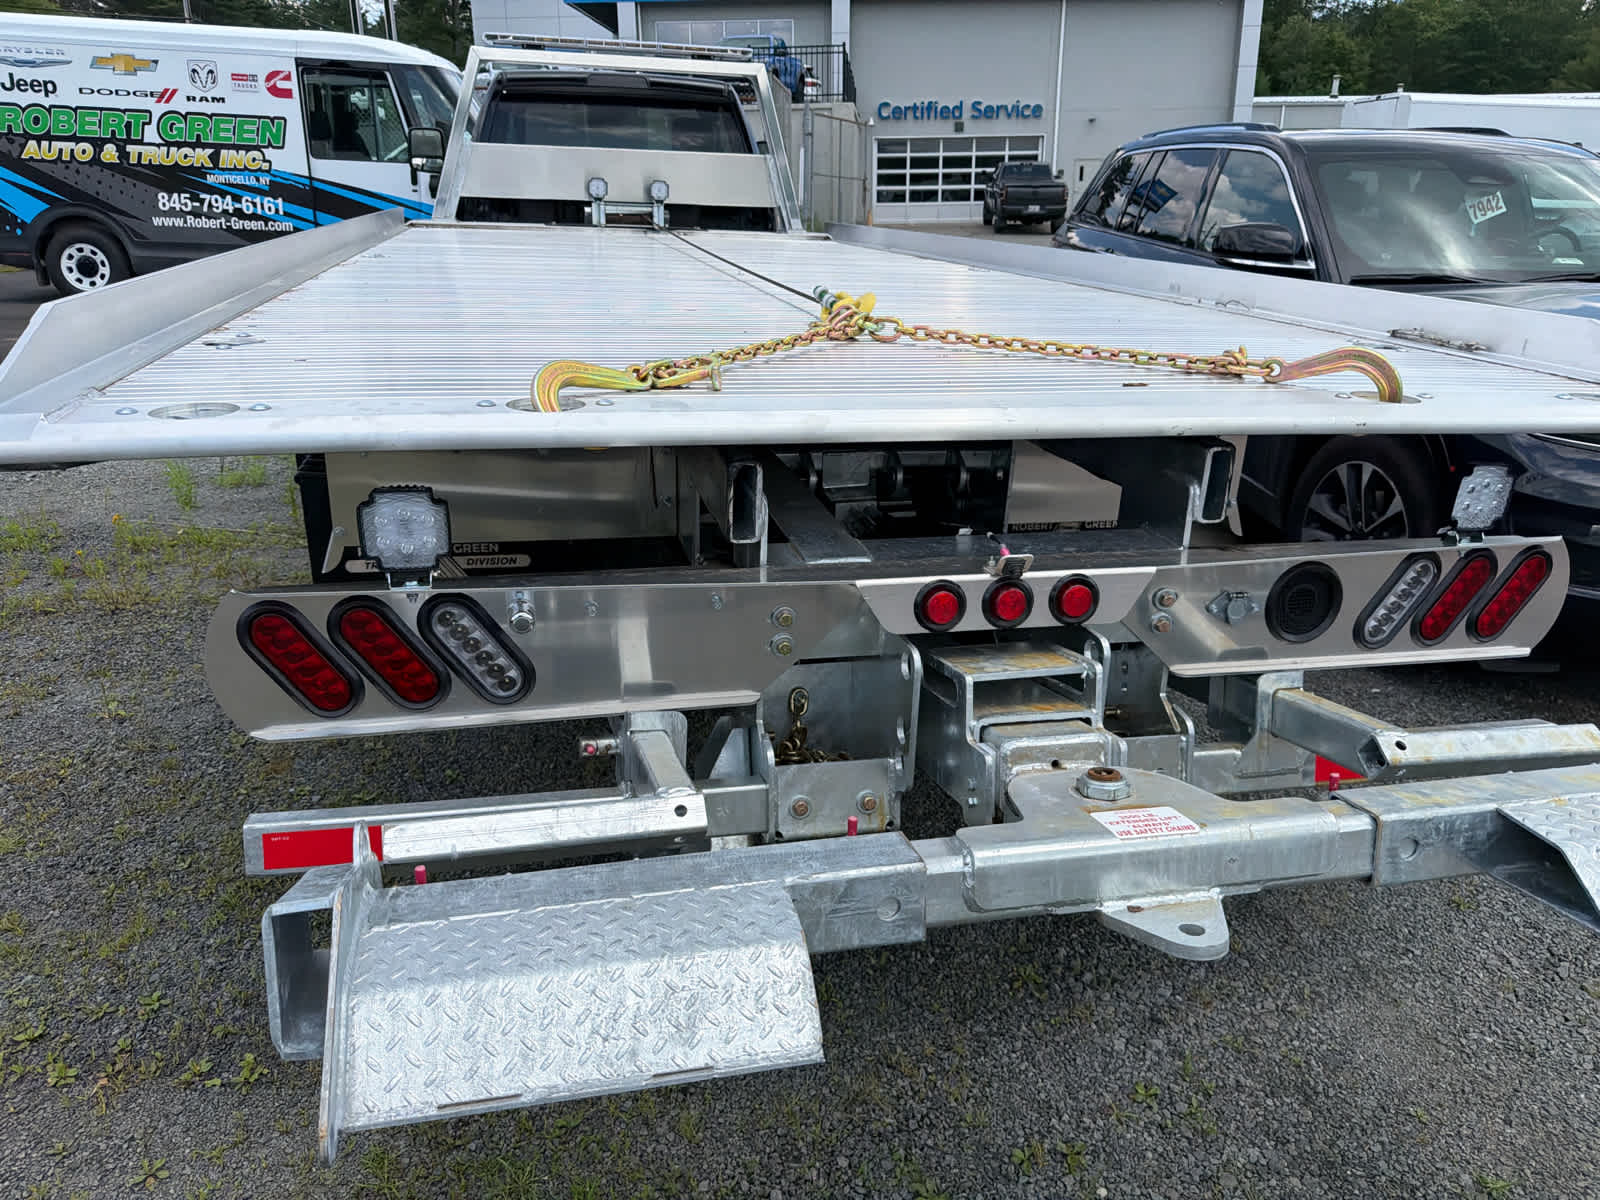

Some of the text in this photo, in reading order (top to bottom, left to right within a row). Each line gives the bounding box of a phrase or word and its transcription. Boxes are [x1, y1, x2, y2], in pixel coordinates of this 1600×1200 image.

[0, 72, 57, 98] Jeep
[78, 87, 164, 98] DODGE
[186, 95, 226, 104] RAM
[877, 100, 1043, 121] Certified Service
[0, 105, 286, 148] ROBERT GREEN
[21, 139, 271, 171] AUTO & TRUCK INC.
[206, 173, 271, 187] MONTICELLO, NY
[156, 191, 285, 216] 845-794-6161
[1468, 193, 1503, 221] 7942
[151, 215, 294, 232] www.Robert-Green.com
[452, 543, 499, 554] GREEN
[465, 556, 519, 568] DIVISION
[1134, 826, 1165, 837] SAFETY
[1164, 823, 1196, 834] CHAINS
